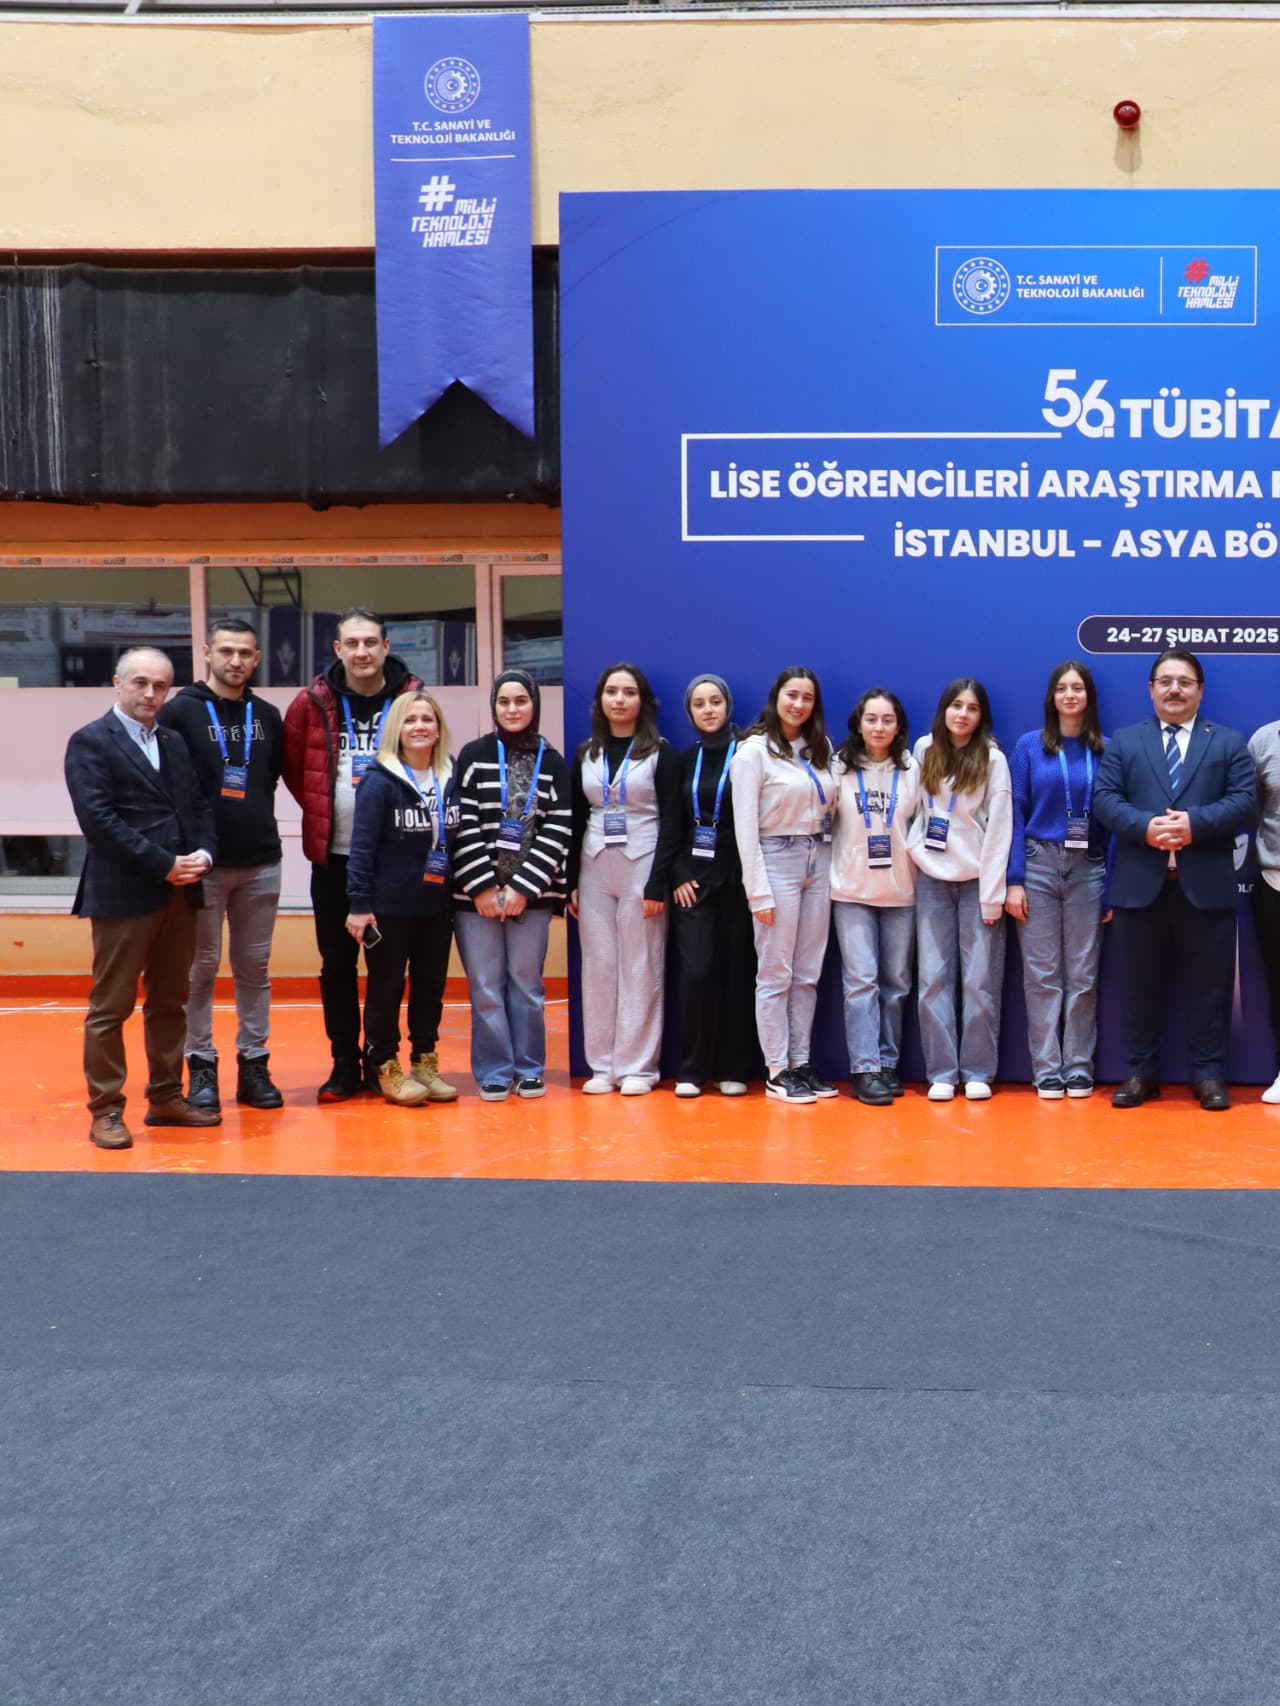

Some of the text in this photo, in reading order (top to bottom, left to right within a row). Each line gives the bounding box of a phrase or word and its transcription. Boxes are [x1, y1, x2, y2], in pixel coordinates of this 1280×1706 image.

[412, 118, 493, 132] T.C. SANAYİ VE
[390, 129, 516, 144] TEKNOLOJİ BAKANLIĞI
[1016, 273, 1098, 285] T.C. SANAYİ VE
[1016, 286, 1145, 298] TEKNOLOJİ BAKANLIĞI
[710, 462, 780, 499] LİSE
[788, 461, 1029, 499] ÖĞRENCİLERİ
[1037, 469, 1263, 508] ARAŞTIRMA
[894, 521, 1076, 558] İSTANBUL
[1111, 529, 1217, 558] ASYA
[1166, 628, 1230, 648] ŞUBAT
[1232, 628, 1280, 643] 2025
